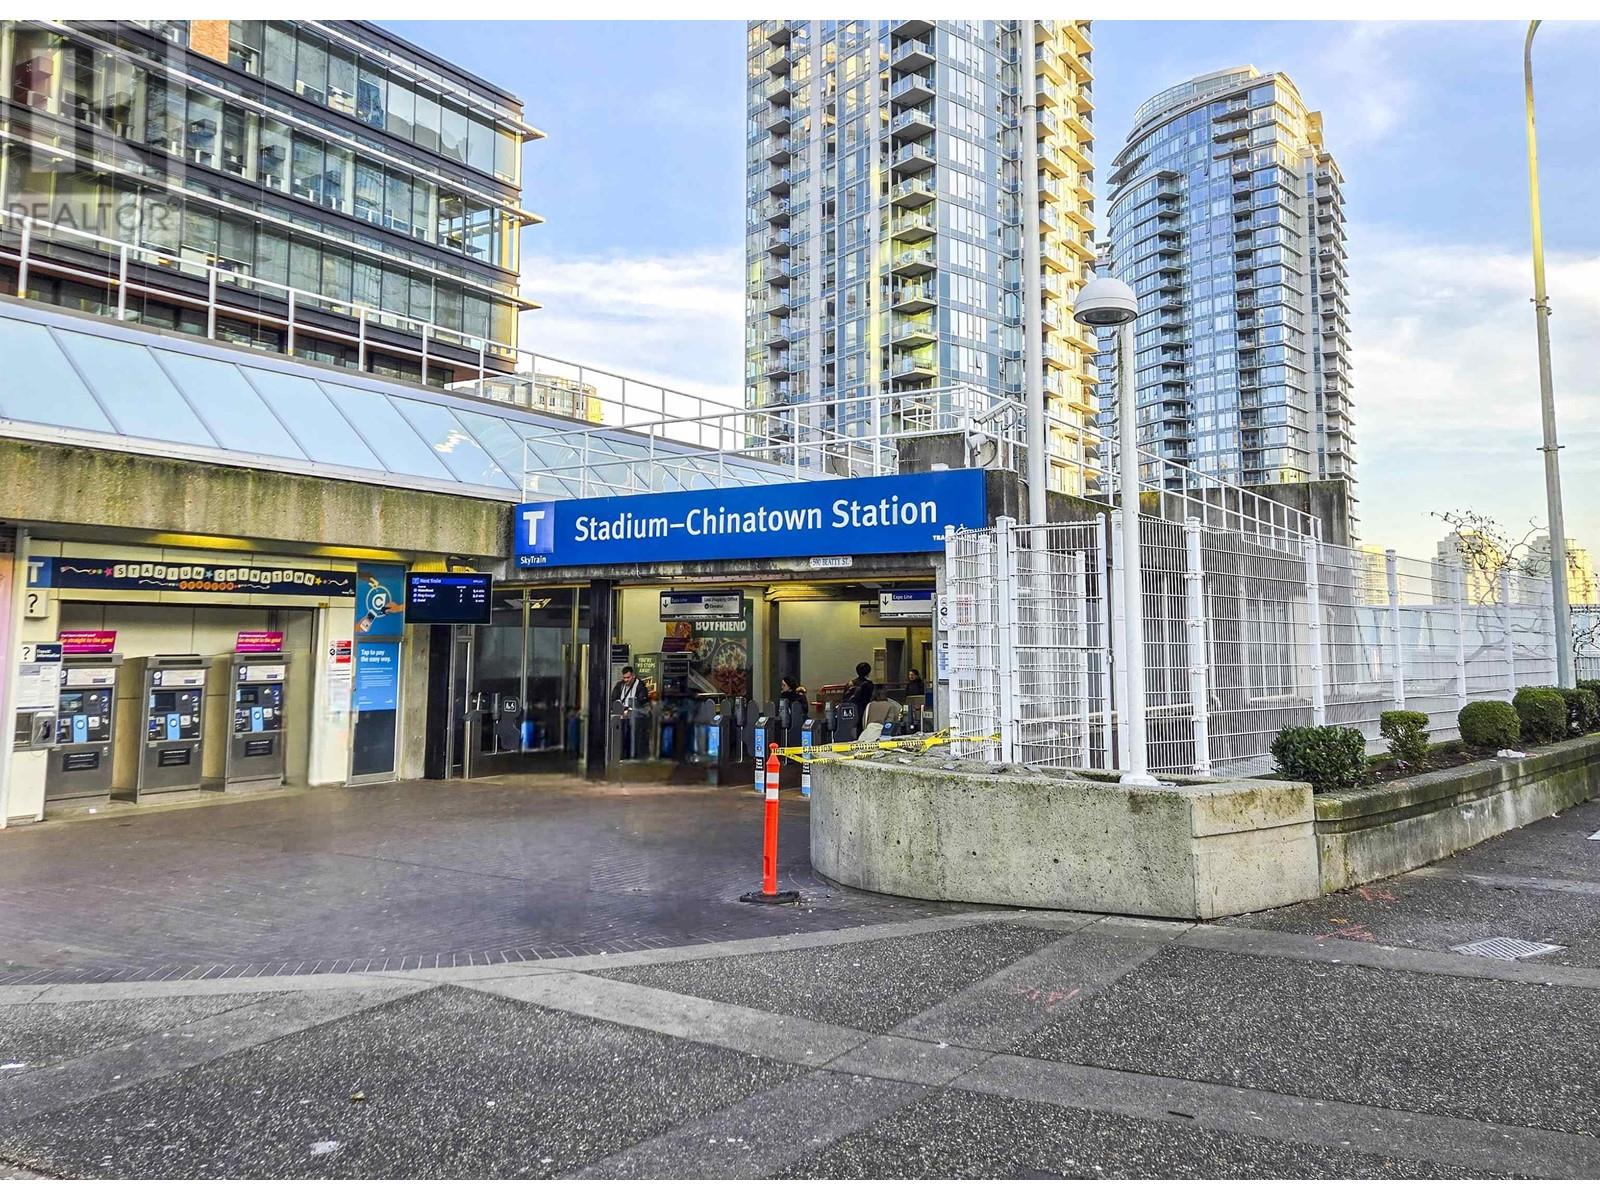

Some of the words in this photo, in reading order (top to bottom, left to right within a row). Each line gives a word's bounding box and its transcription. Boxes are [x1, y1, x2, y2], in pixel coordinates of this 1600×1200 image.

[831, 494, 937, 528] Station
[522, 510, 545, 546] T
[520, 555, 547, 566] SkyTrain
[116, 565, 204, 579] STADIUM
[215, 569, 313, 584] CHINATOWN
[695, 620, 747, 632] BOYFRIEND
[802, 745, 833, 753] CAUTION
[849, 743, 880, 751] CAUTION
